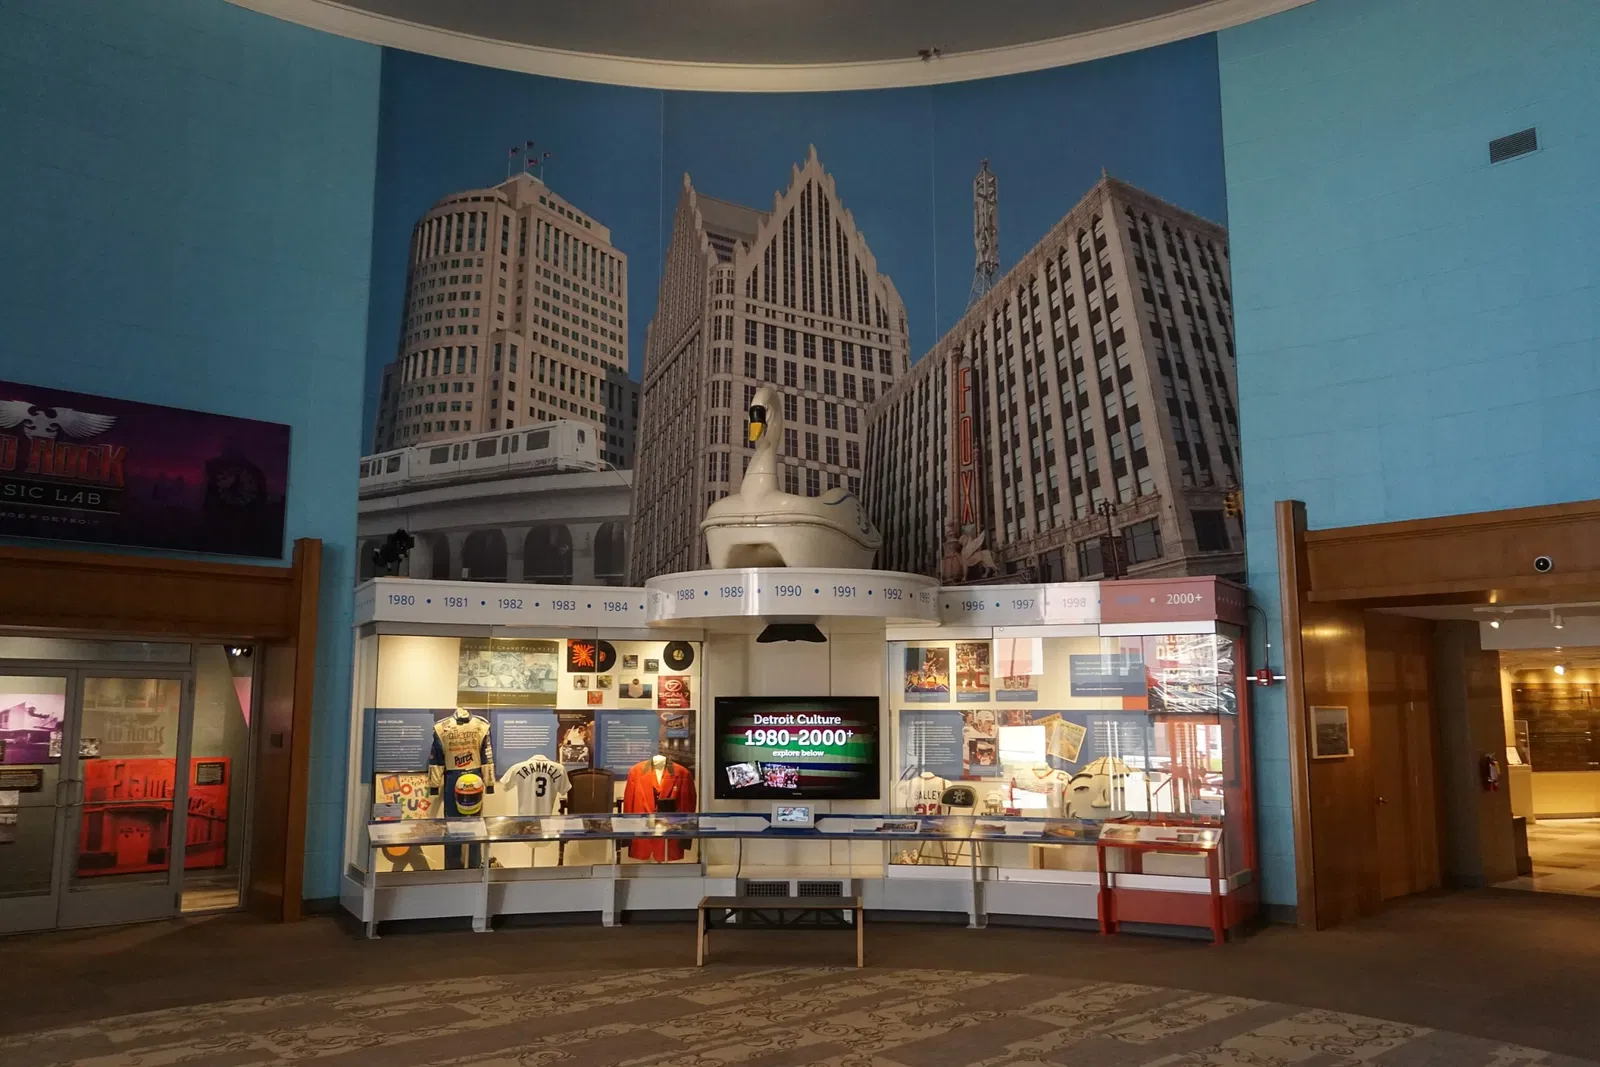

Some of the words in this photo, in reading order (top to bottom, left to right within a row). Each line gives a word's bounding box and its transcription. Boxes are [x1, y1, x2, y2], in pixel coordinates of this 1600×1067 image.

[959, 367, 974, 525] FOX
[25, 435, 128, 487] ROCK
[4, 484, 43, 499] SIC
[56, 489, 101, 505] LAB
[677, 589, 695, 600] 1988
[719, 586, 744, 598] 1989
[774, 585, 802, 597] 1990
[832, 586, 857, 597] 1991
[883, 588, 903, 600] 1992
[1166, 593, 1203, 605] 2000+
[388, 594, 415, 605] 1980
[444, 597, 469, 608] 1981
[498, 599, 523, 609] 1982
[552, 601, 576, 611] 1983
[603, 602, 628, 612] 1984
[961, 601, 985, 611] 1996
[1011, 600, 1035, 610] 1997
[1062, 598, 1087, 608] 1998
[753, 714, 795, 725] Detroit
[797, 714, 842, 725] Culture
[744, 729, 854, 746] 1980-2000+
[772, 749, 800, 757] explore
[801, 749, 825, 757] below
[516, 762, 562, 783] TRAMMELL
[535, 776, 547, 798] 3
